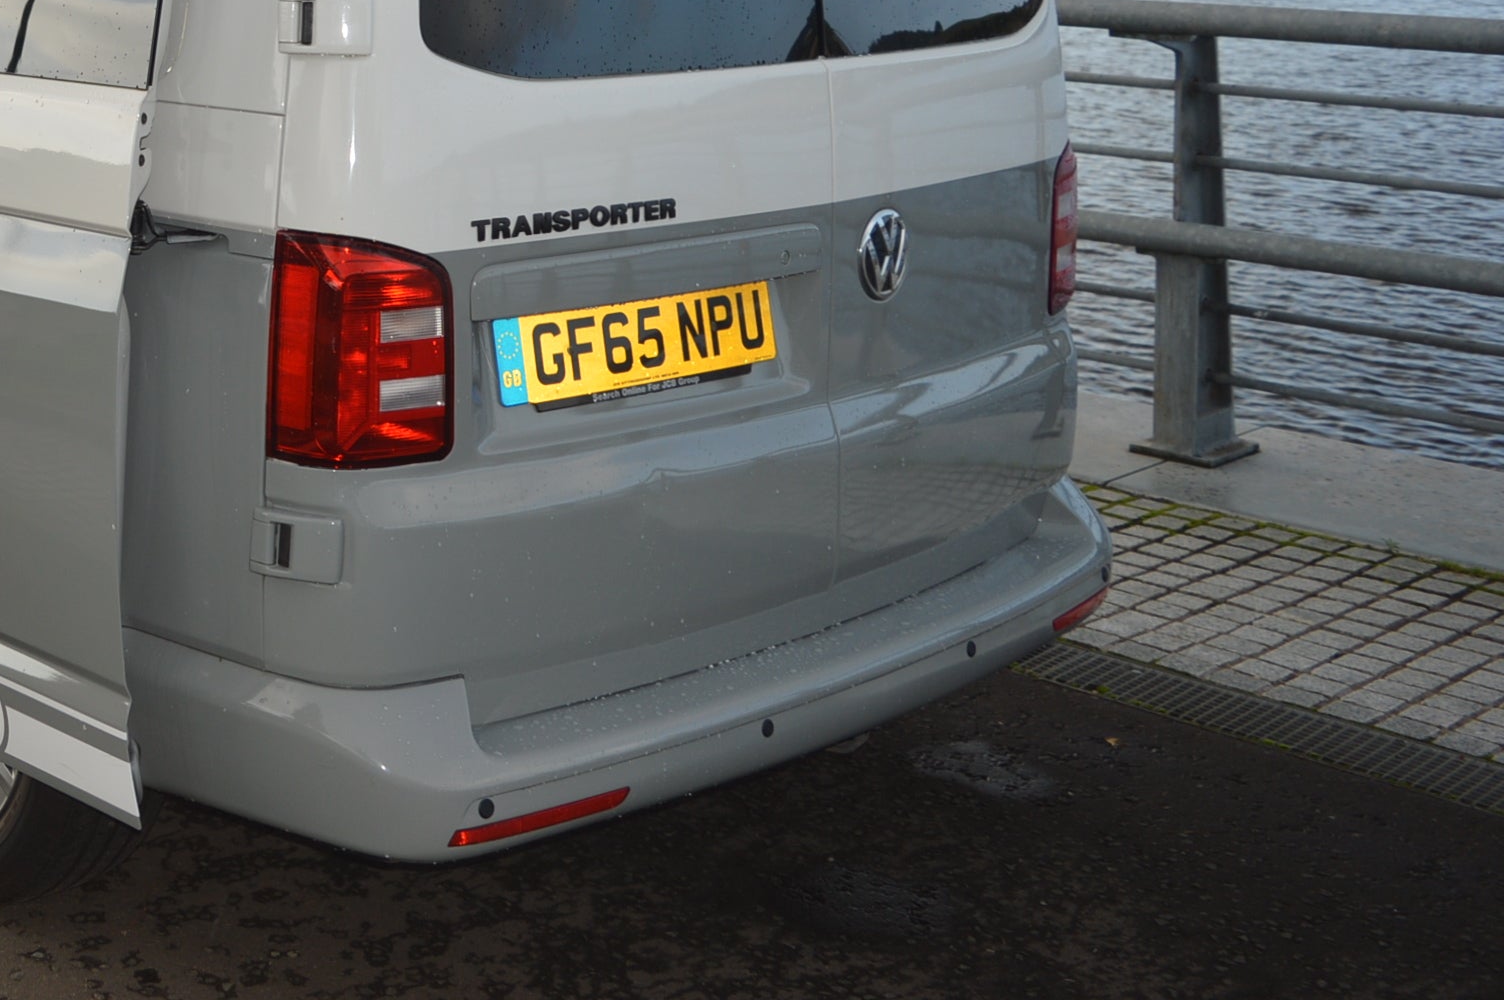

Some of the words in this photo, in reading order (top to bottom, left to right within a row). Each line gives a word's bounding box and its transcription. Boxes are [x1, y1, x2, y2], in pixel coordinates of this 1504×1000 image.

[471, 198, 676, 242] TRANSPORTER
[860, 209, 906, 301] VW
[532, 306, 665, 386] GF65
[676, 289, 764, 362] NPU
[502, 369, 522, 388] GB
[592, 391, 620, 402] Search
[621, 386, 647, 397] Online
[647, 382, 661, 392] For
[677, 375, 700, 386] Group
